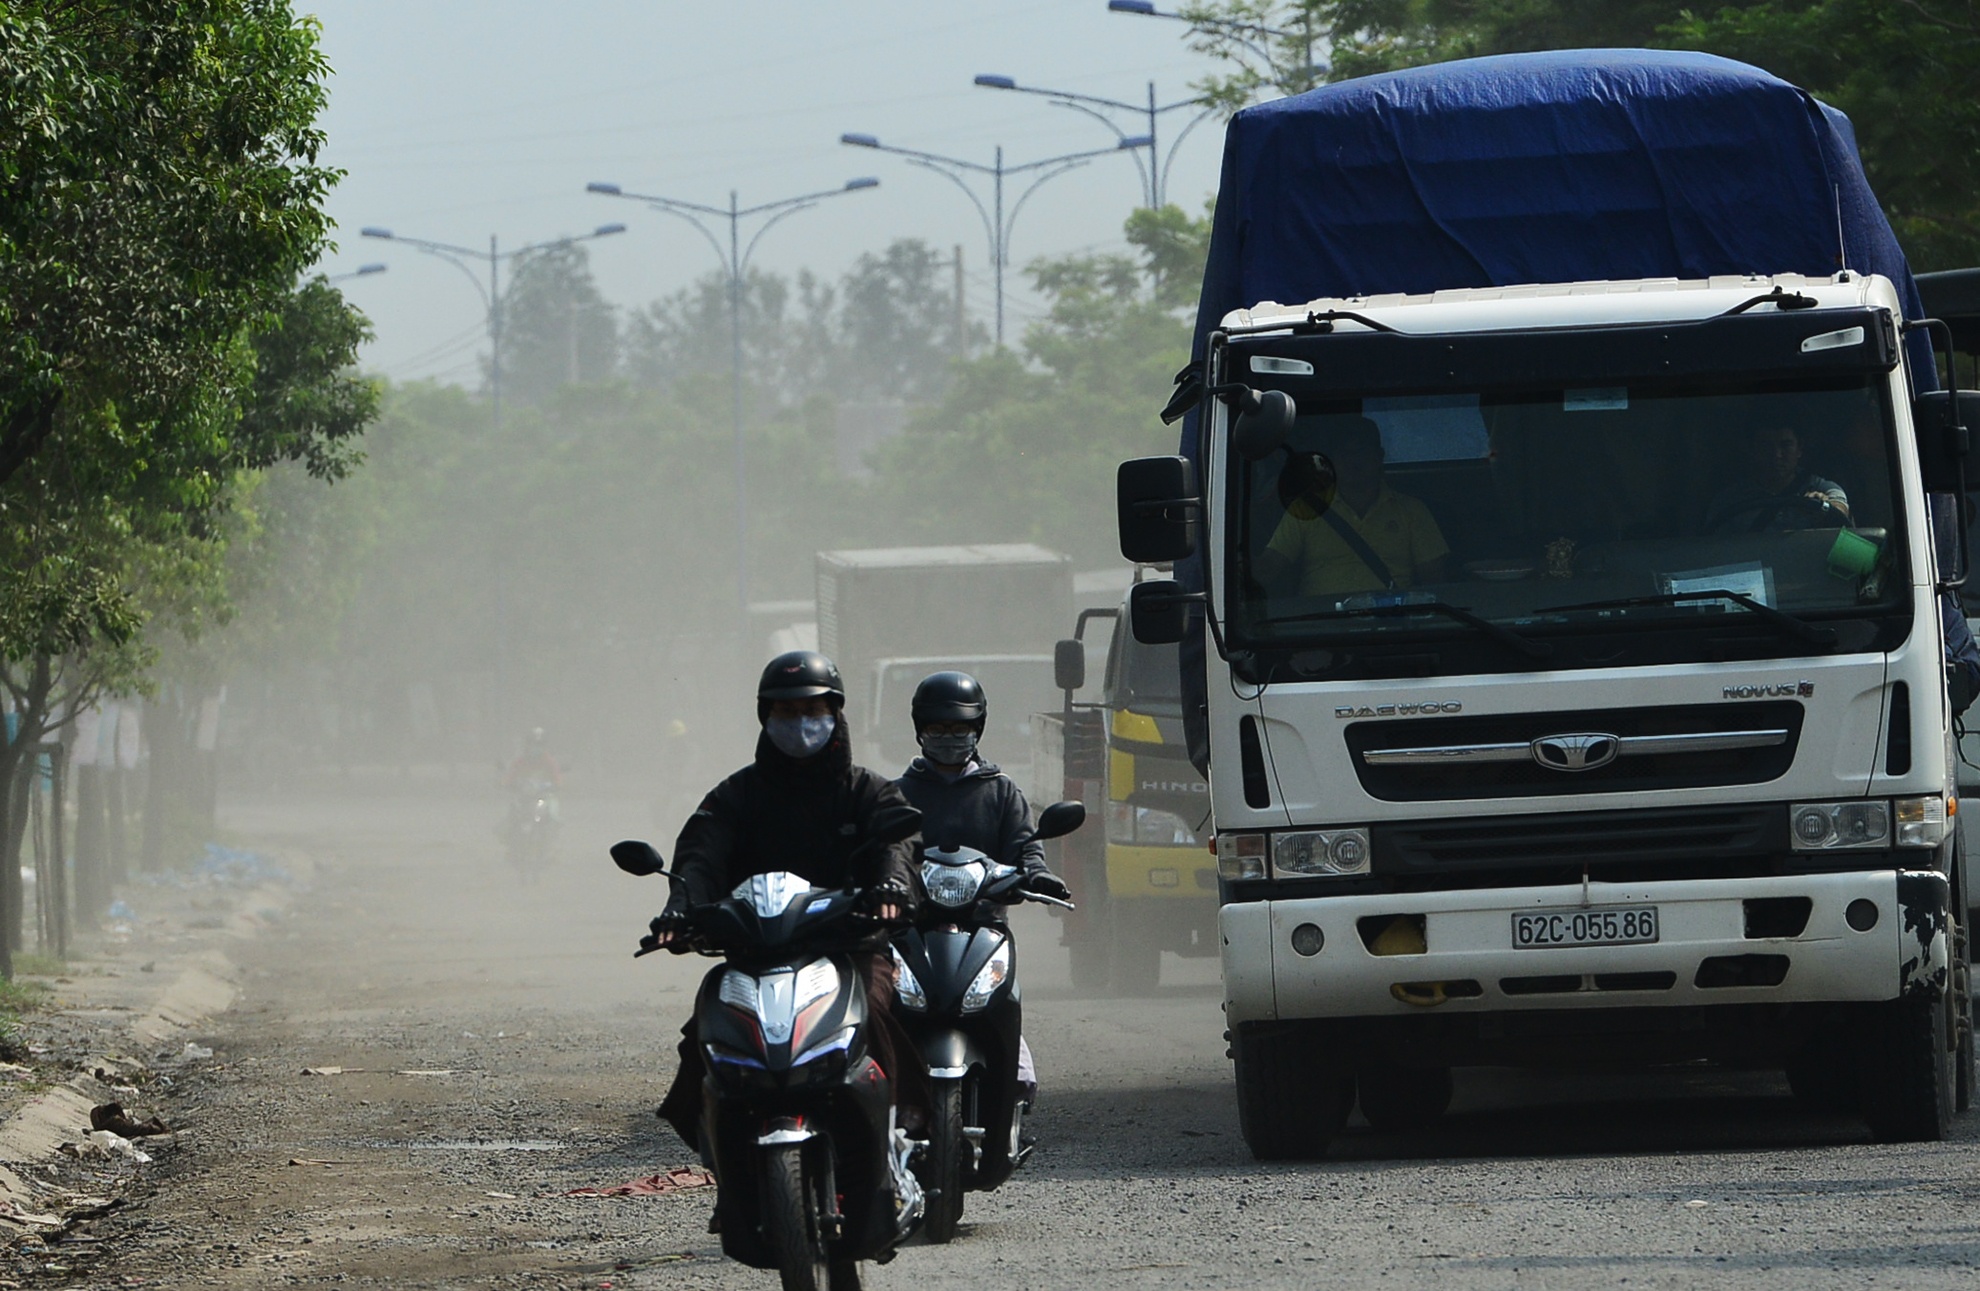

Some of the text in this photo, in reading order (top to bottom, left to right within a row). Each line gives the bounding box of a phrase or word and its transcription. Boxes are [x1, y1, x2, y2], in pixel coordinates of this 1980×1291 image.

[1722, 683, 1796, 699] NOVUS
[1334, 700, 1462, 719] DAEWOO
[1142, 780, 1207, 793] HINO
[1518, 911, 1653, 944] 62C-055.86
